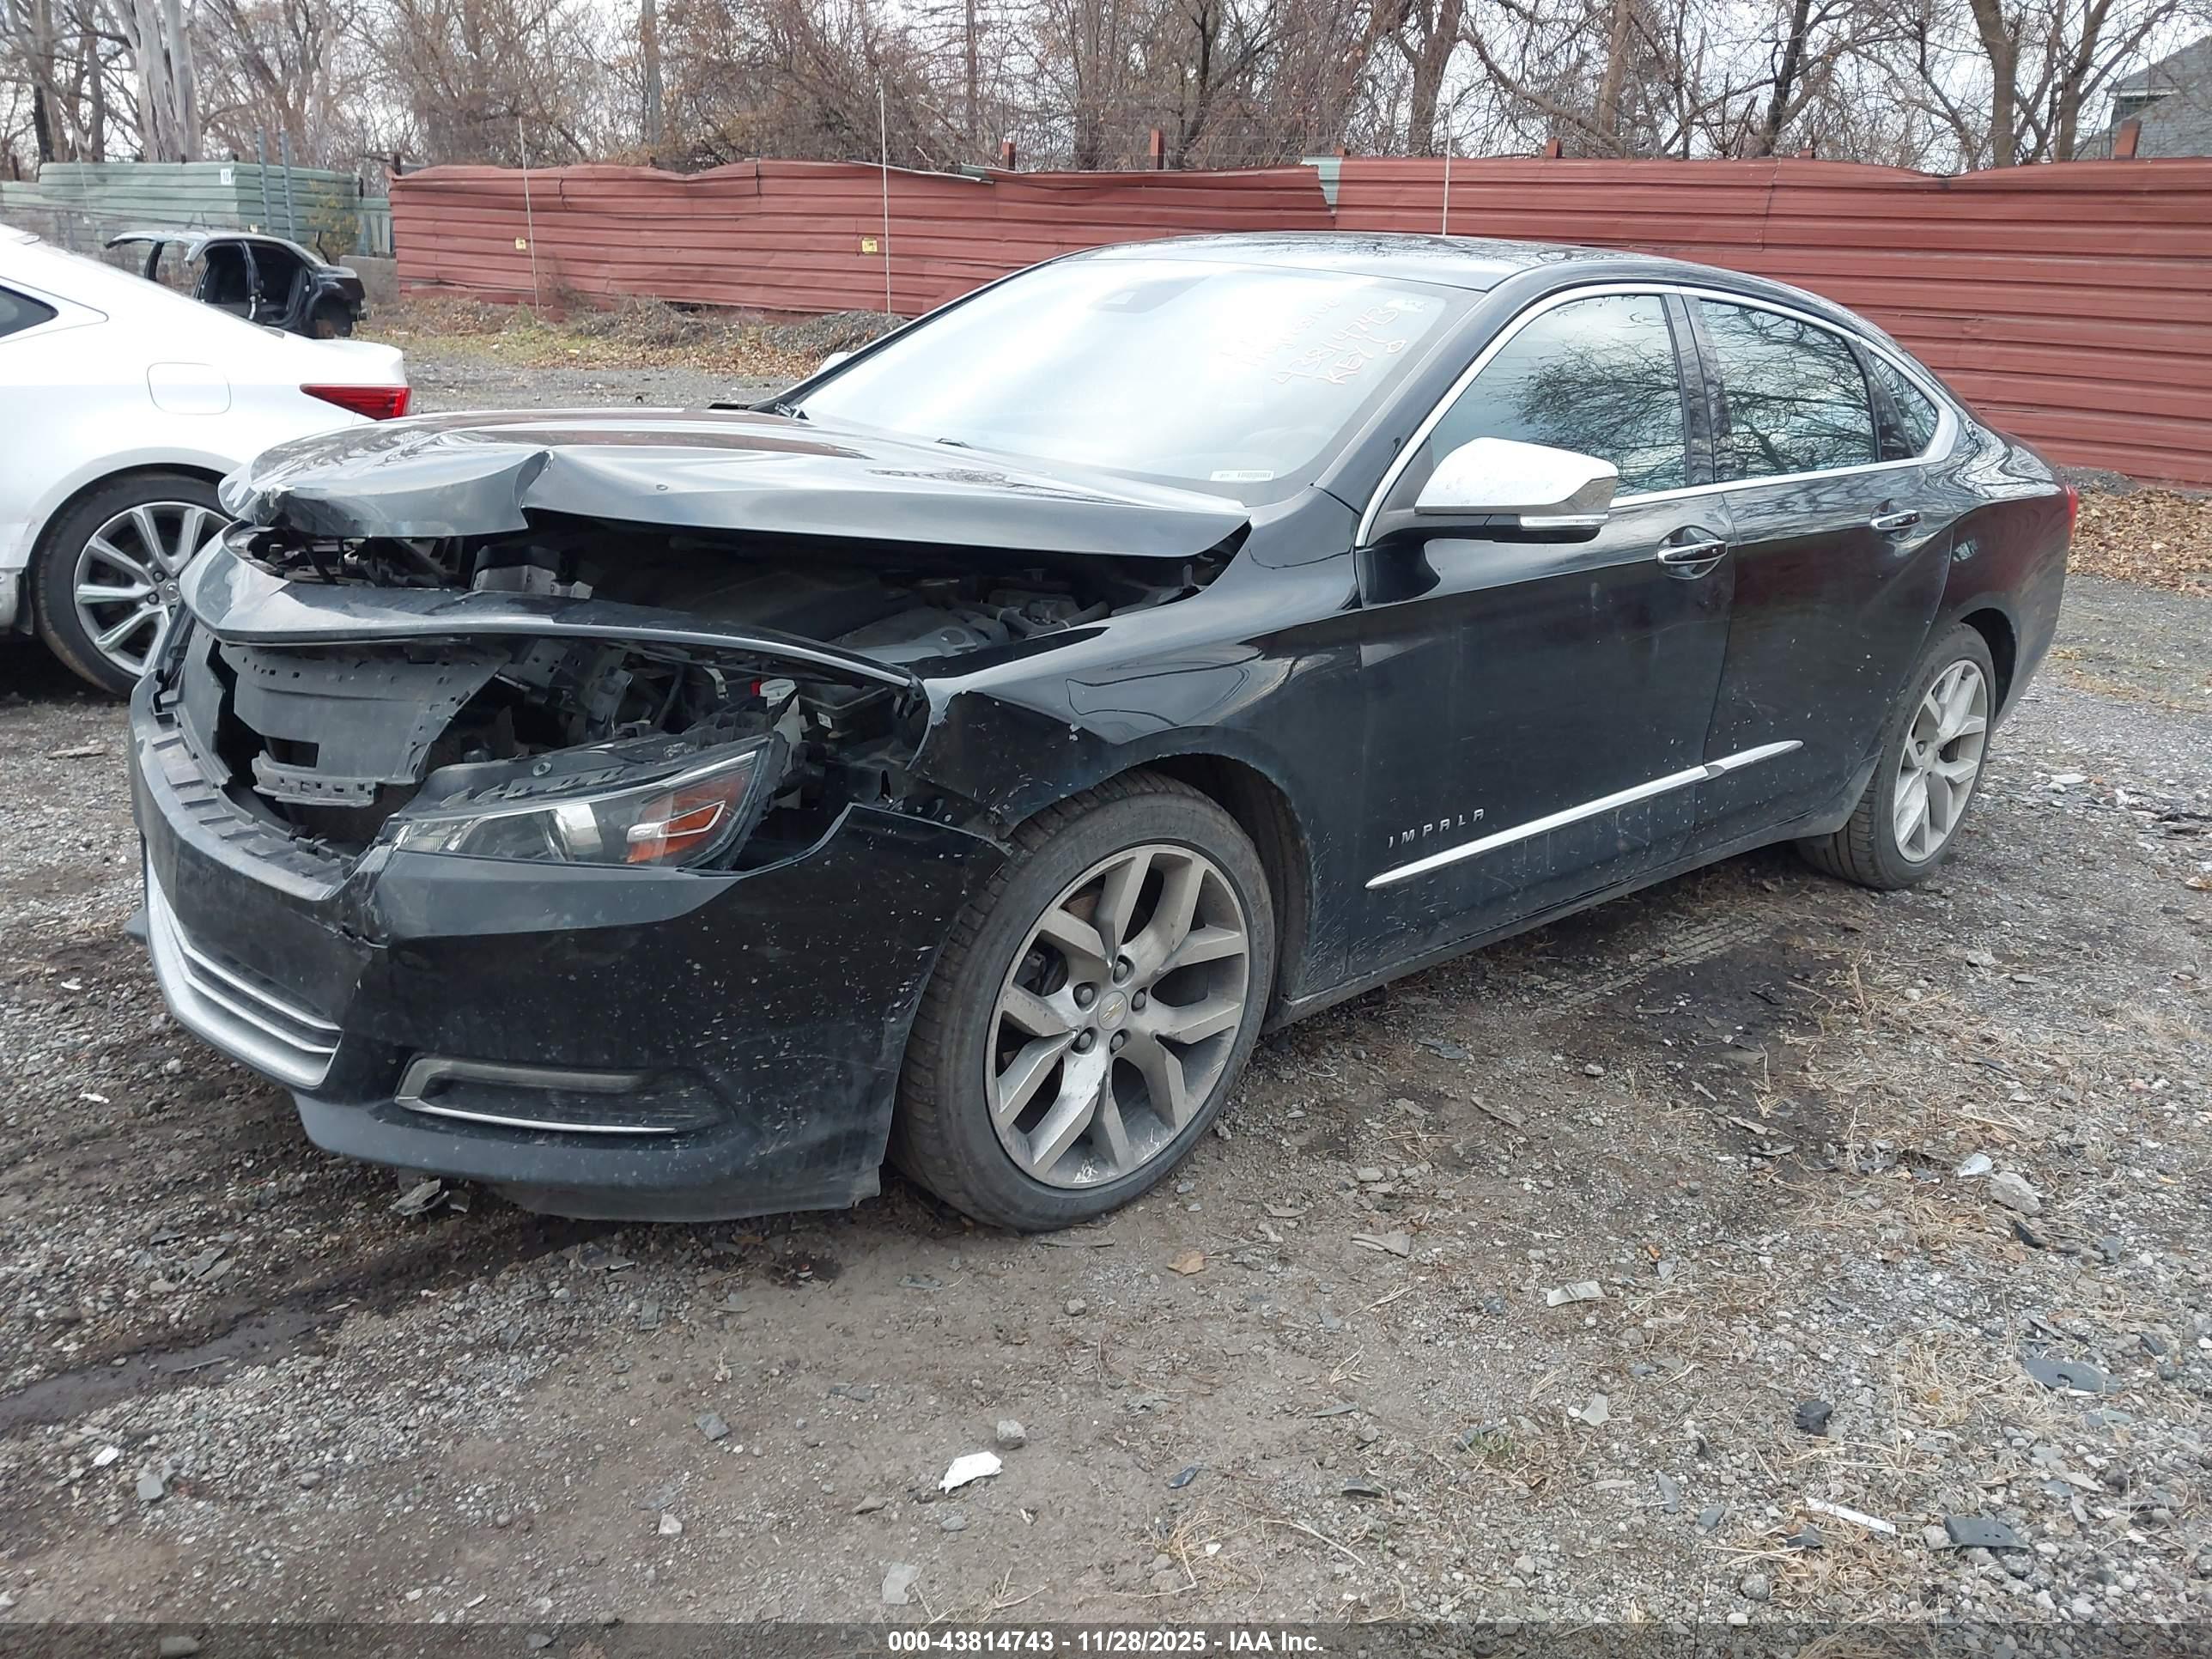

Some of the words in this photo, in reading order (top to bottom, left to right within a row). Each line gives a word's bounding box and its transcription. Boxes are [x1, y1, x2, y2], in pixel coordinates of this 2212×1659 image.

[222, 171, 229, 182] 10
[1271, 307, 1399, 384] 43814743
[1388, 807, 1485, 848] IMPALA
